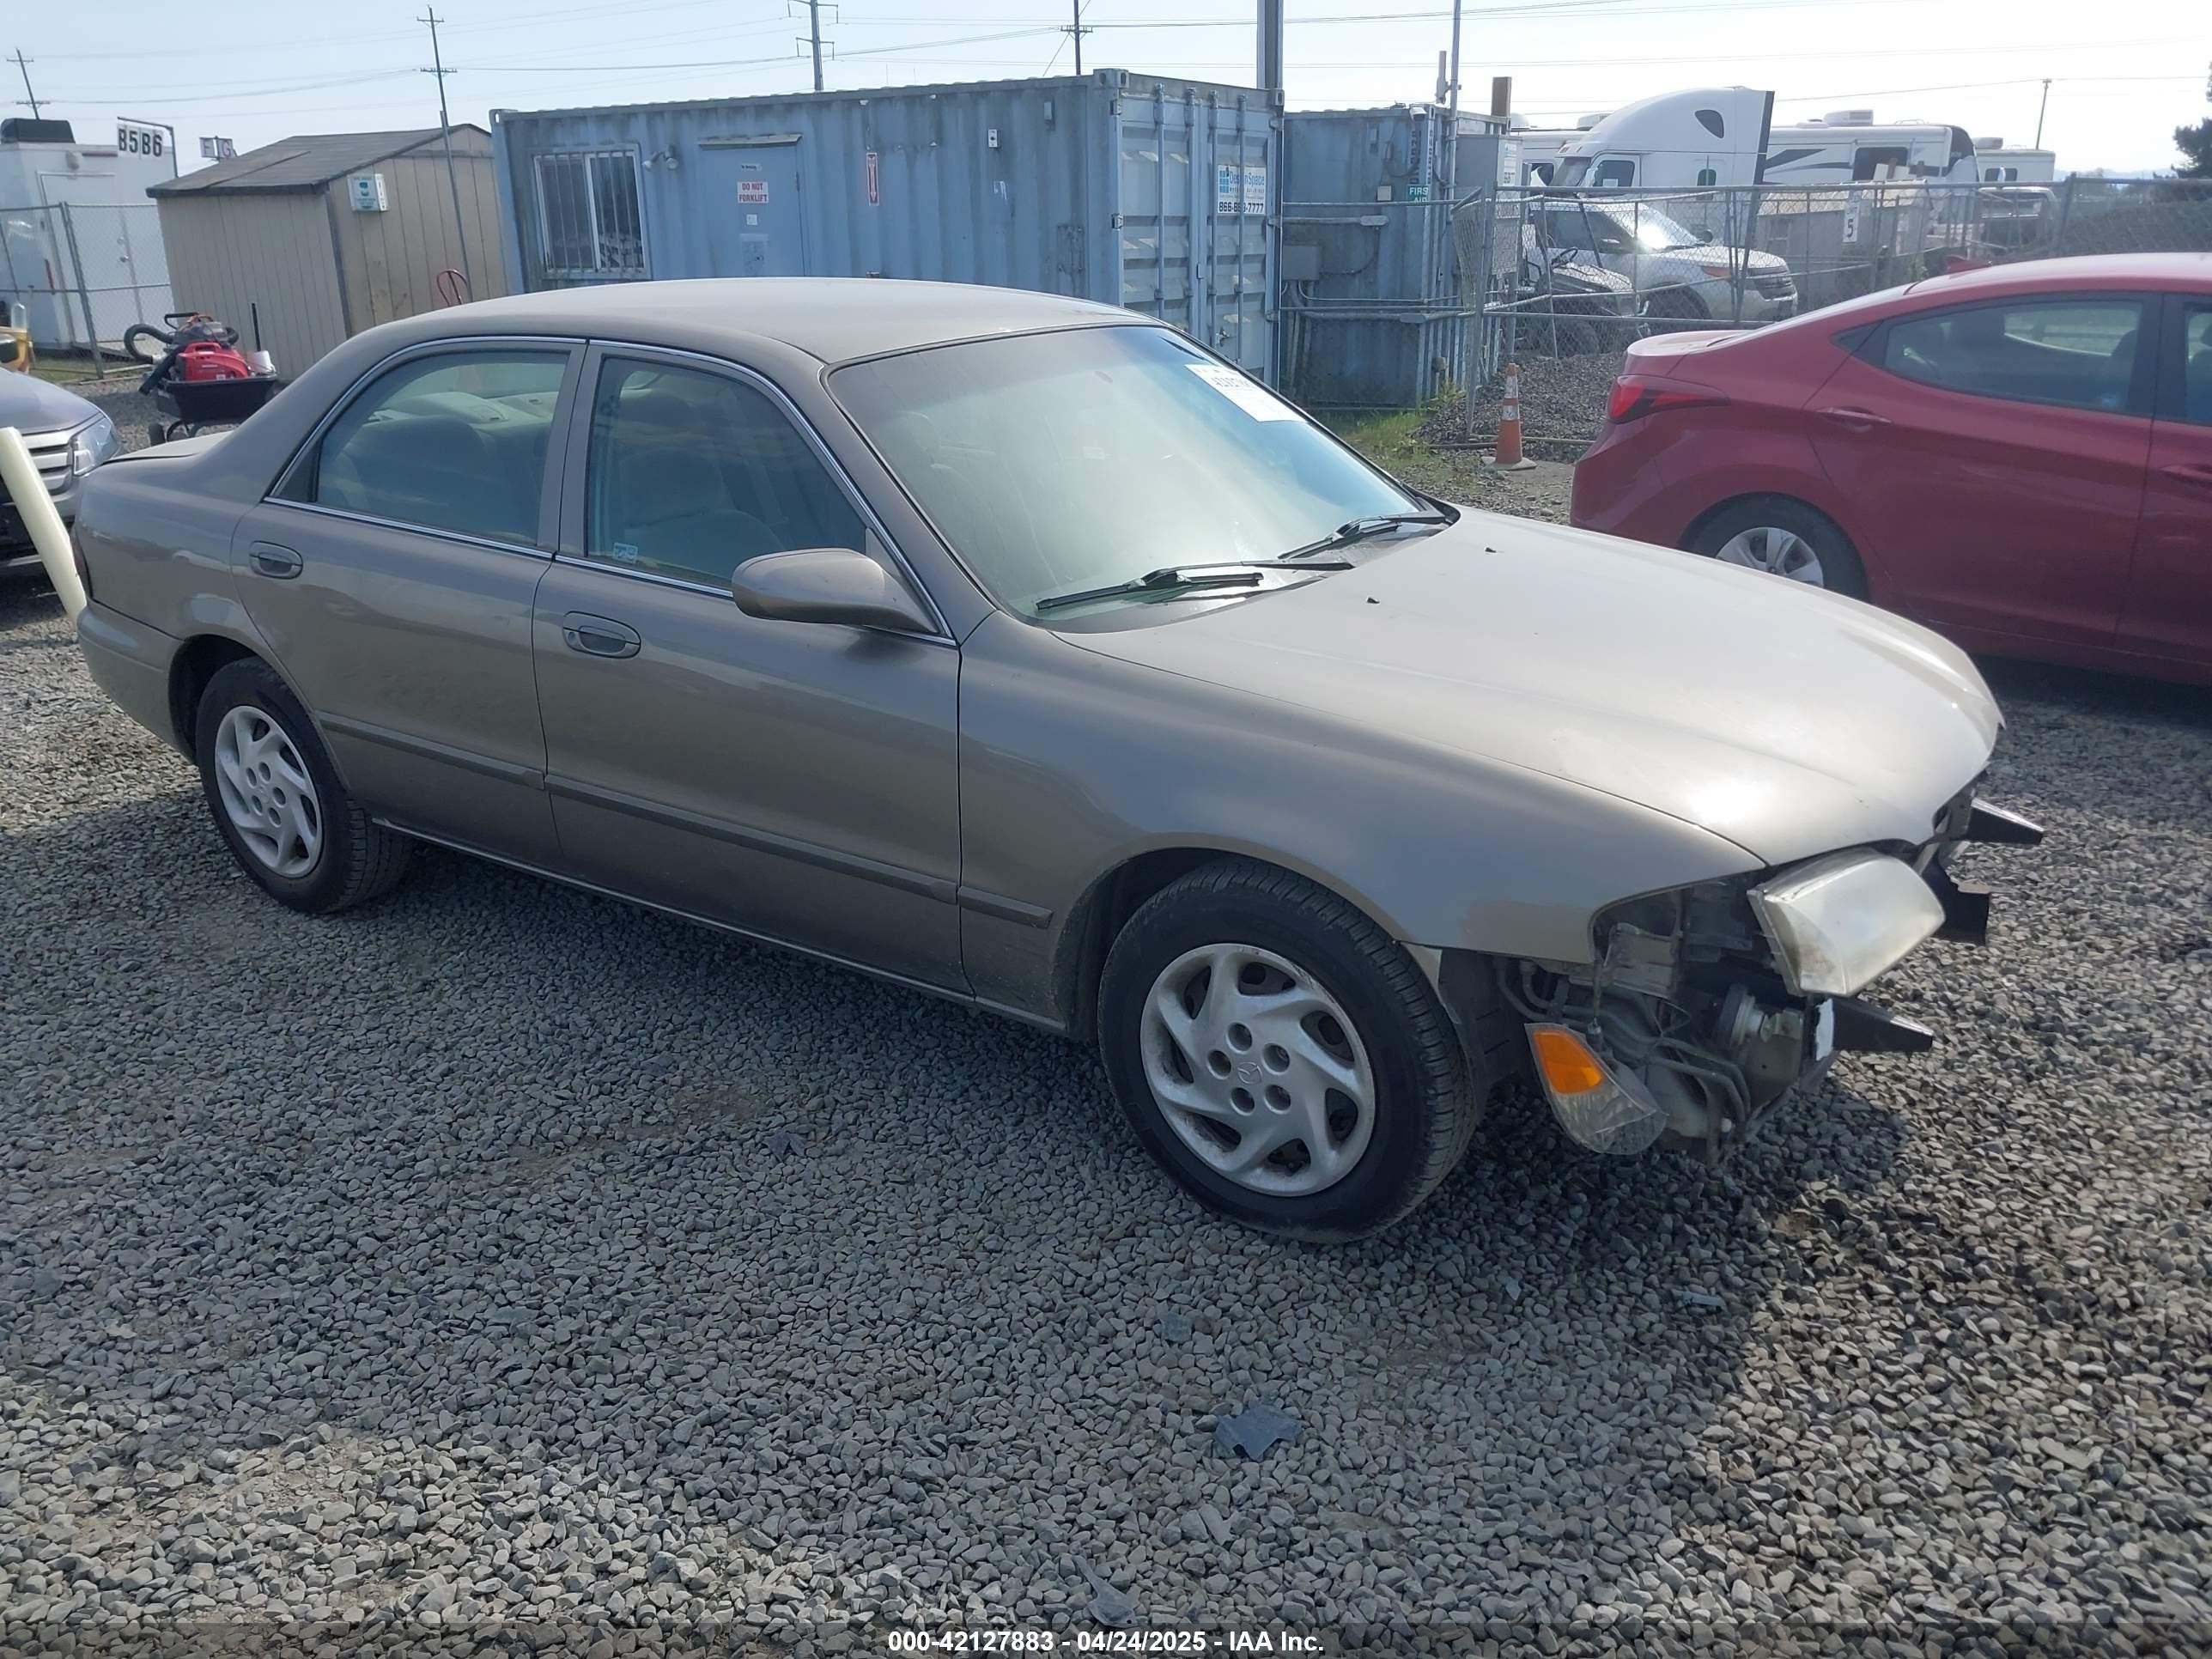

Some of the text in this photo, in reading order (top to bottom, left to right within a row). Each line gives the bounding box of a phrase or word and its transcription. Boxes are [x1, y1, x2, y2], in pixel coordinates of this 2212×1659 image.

[222, 140, 232, 158] G
[1229, 171, 1265, 186] DesnSpace
[738, 194, 768, 203] FORKLIFT
[1409, 187, 1429, 196] FIRS
[1847, 218, 1854, 238] 5
